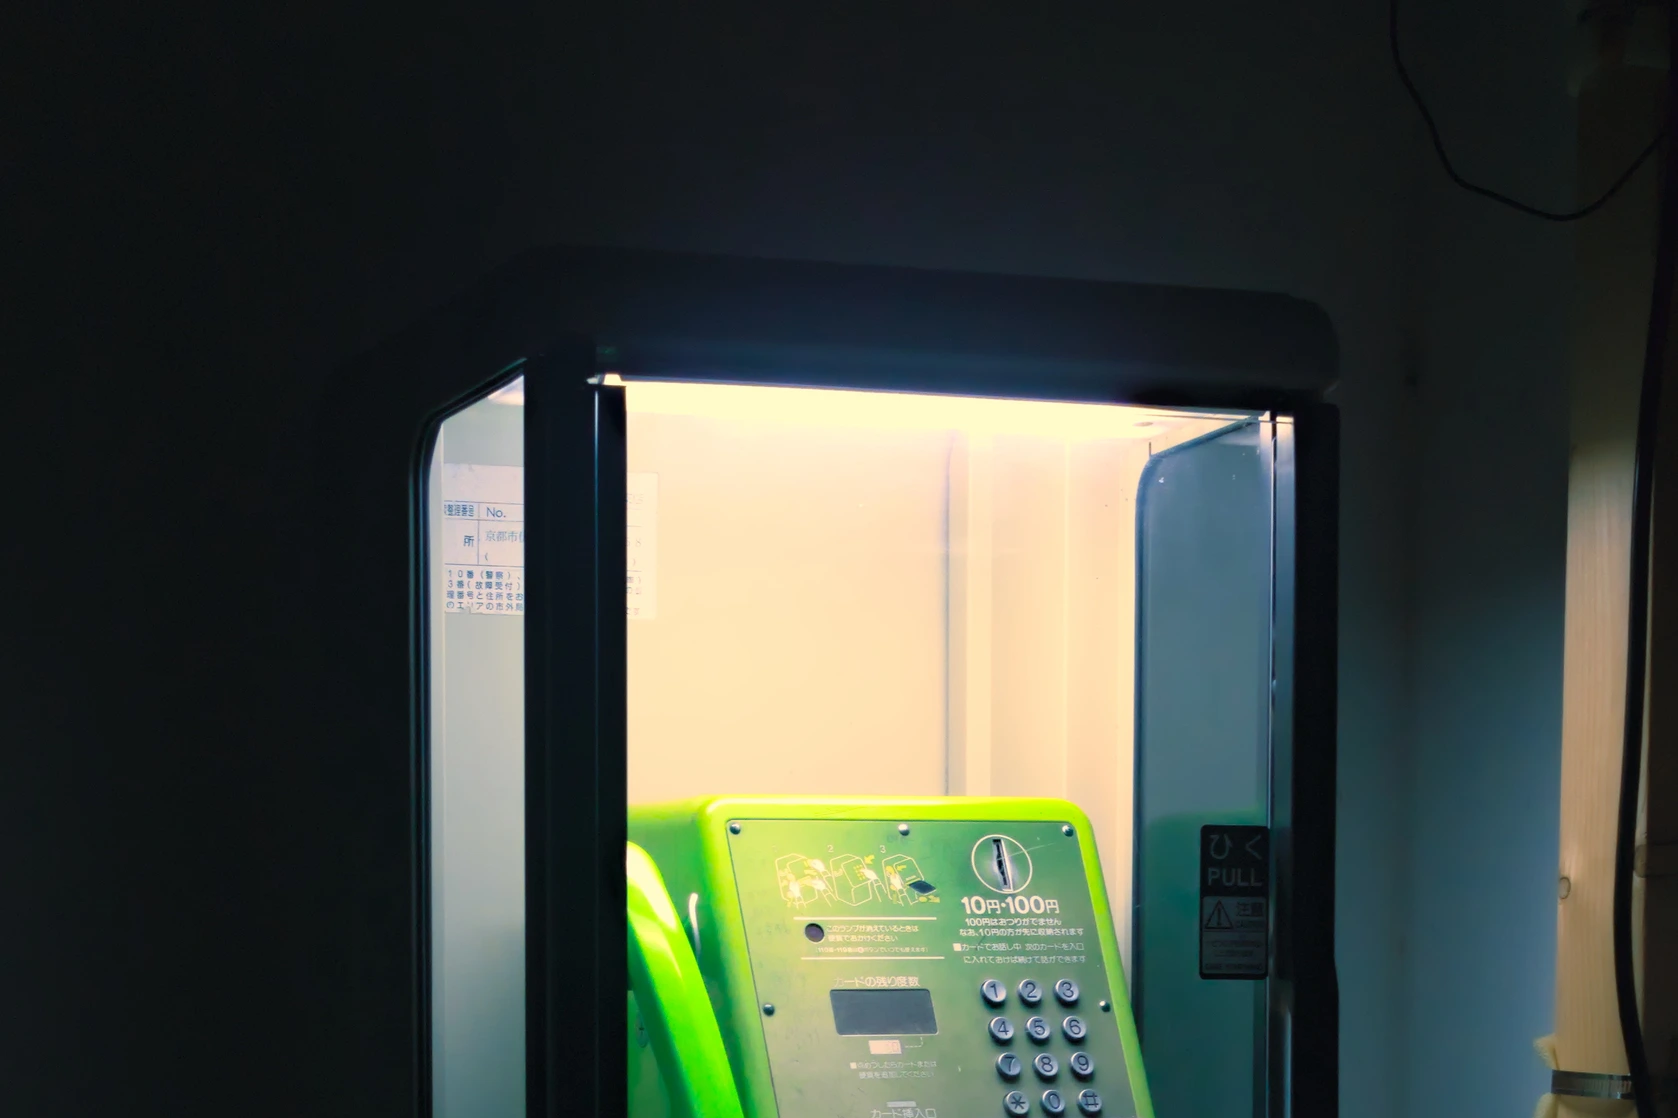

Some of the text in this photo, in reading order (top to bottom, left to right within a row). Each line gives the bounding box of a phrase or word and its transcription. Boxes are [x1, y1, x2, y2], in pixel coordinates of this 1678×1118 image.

[486, 507, 506, 518] No.
[827, 845, 834, 853] 2
[880, 845, 886, 853] 3
[1208, 867, 1262, 887] PULL
[835, 976, 921, 987] カードの残り度数
[990, 982, 1074, 998] 1 2 3
[998, 1020, 1081, 1036] 4 5 6
[1003, 1056, 1089, 1072] 7 8 9
[1049, 1093, 1060, 1109] 0
